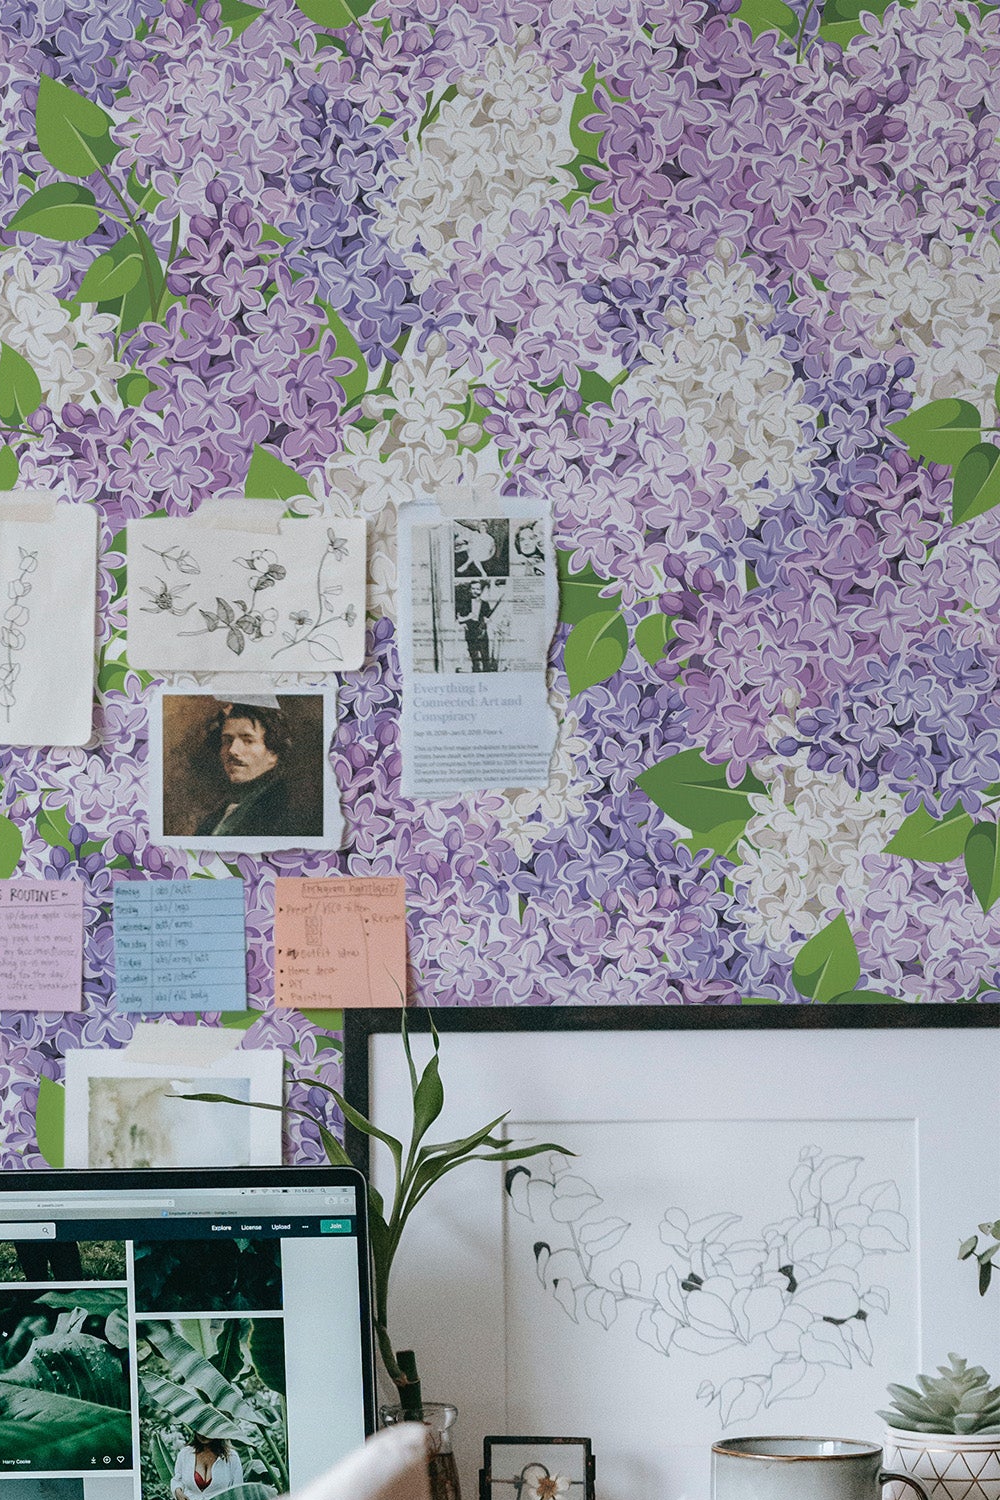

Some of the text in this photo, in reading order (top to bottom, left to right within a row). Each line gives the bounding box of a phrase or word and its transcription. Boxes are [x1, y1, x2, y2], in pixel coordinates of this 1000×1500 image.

[413, 682, 488, 696] Everything Is
[413, 695, 522, 708] Connected: Art and
[413, 711, 477, 724] Conspiracy
[10, 888, 59, 902] ROUTINE
